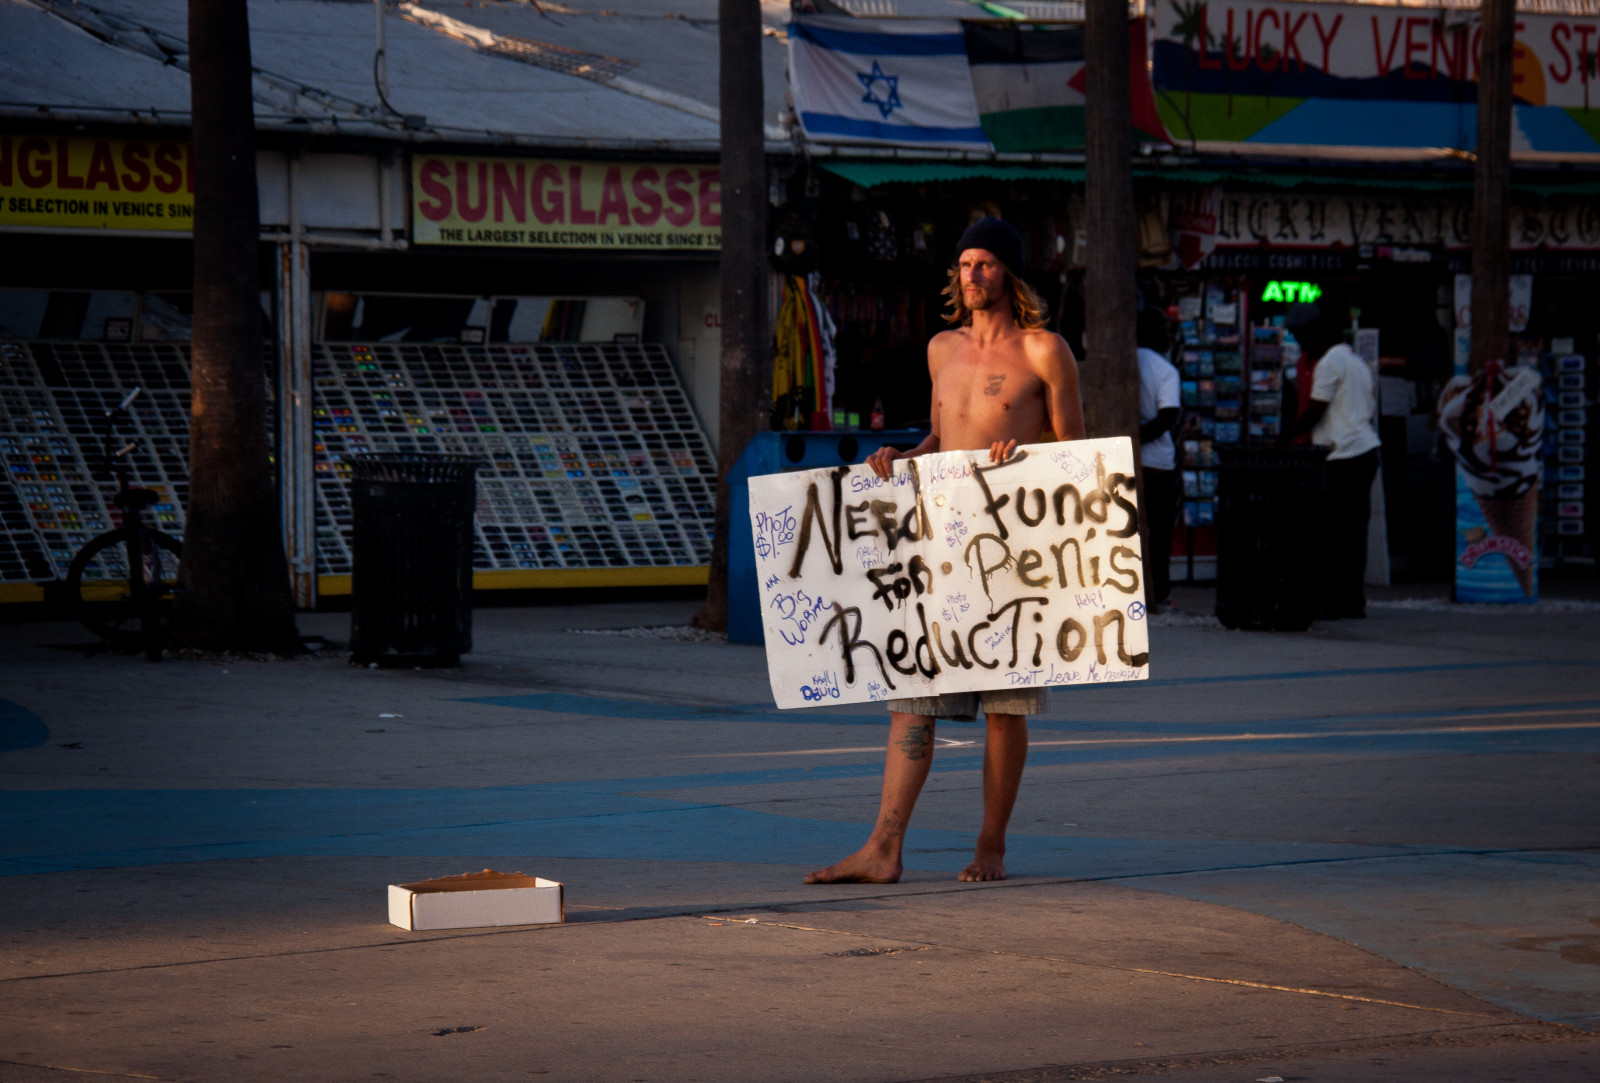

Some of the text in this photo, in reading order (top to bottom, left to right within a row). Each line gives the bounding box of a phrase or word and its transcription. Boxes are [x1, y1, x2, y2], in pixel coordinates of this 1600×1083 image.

[1197, 6, 1344, 76] LUCKY
[1549, 22, 1600, 84] ST
[9, 197, 89, 214] SELECTION
[94, 201, 108, 215] IN
[113, 202, 164, 217] VENICE
[169, 203, 195, 218] SIN
[439, 228, 464, 242] THE
[467, 229, 525, 244] LARGEST
[528, 231, 598, 245] SELECTION
[601, 232, 614, 246] IN
[618, 232, 663, 246] VENICE
[667, 233, 703, 247] SINCE
[964, 527, 1142, 598] Penis
